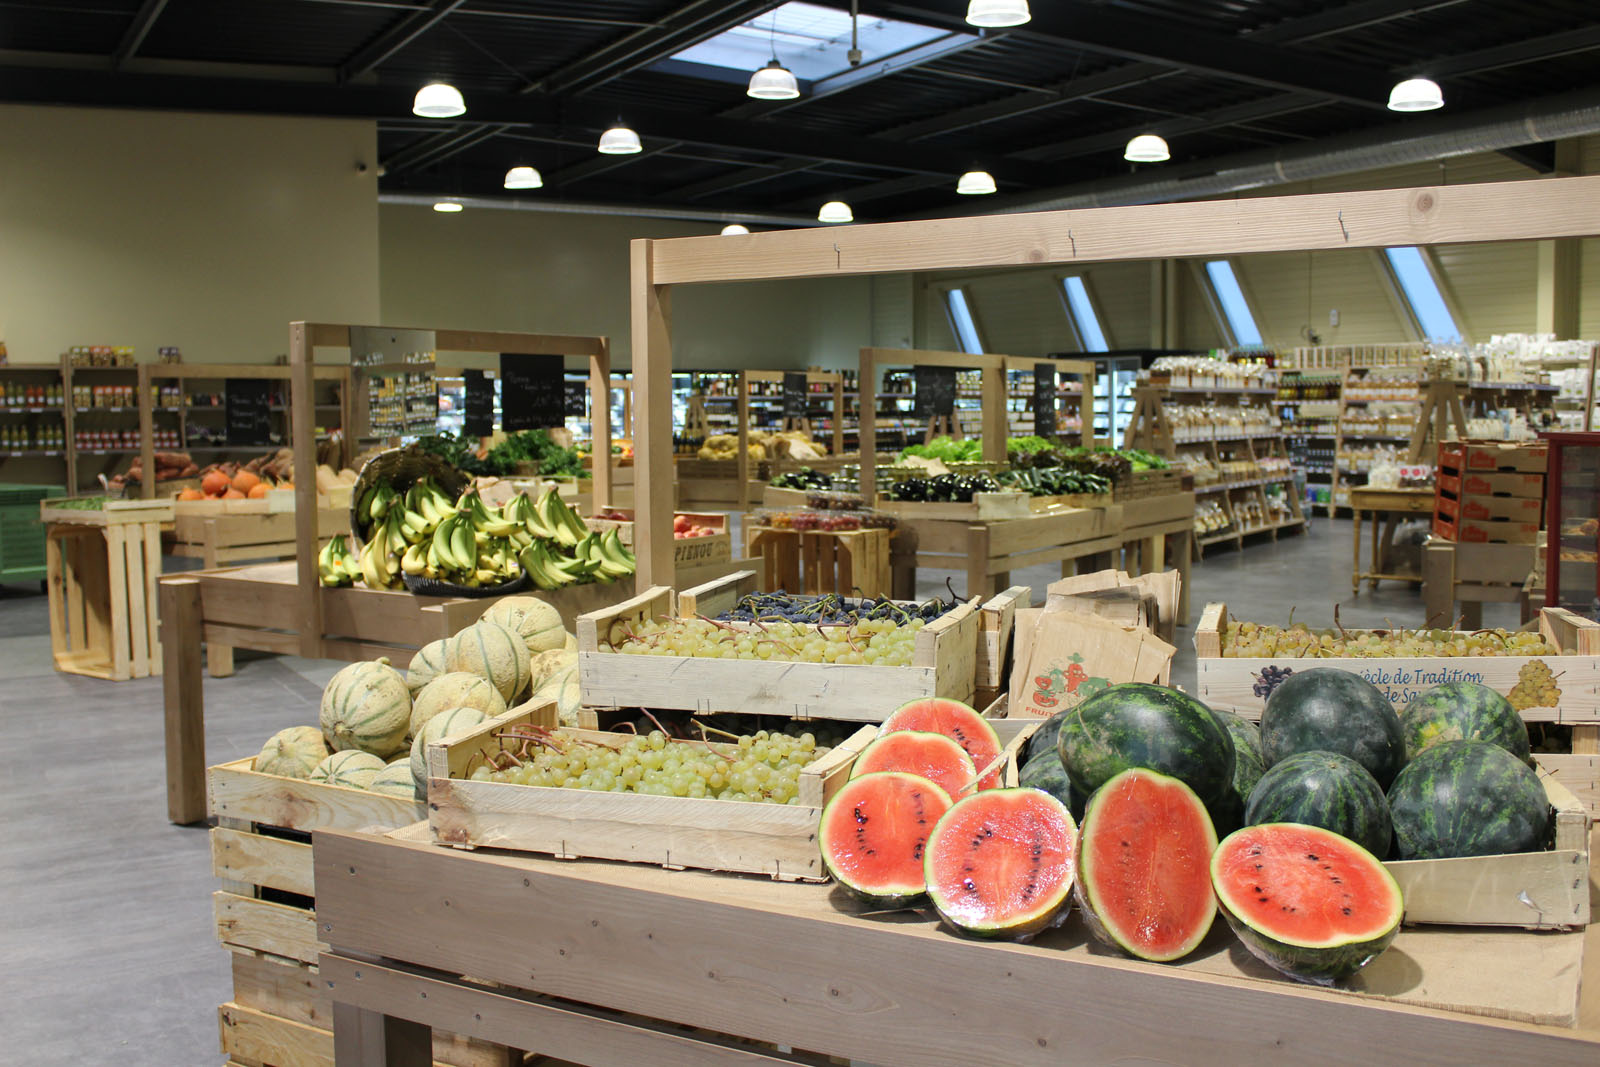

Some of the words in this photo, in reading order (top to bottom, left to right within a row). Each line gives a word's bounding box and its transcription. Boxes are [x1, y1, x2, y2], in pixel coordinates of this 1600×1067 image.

[1360, 668, 1392, 685] ècle
[1393, 667, 1413, 685] de
[1414, 667, 1484, 685] Tradition
[1401, 687, 1421, 704] Sa
